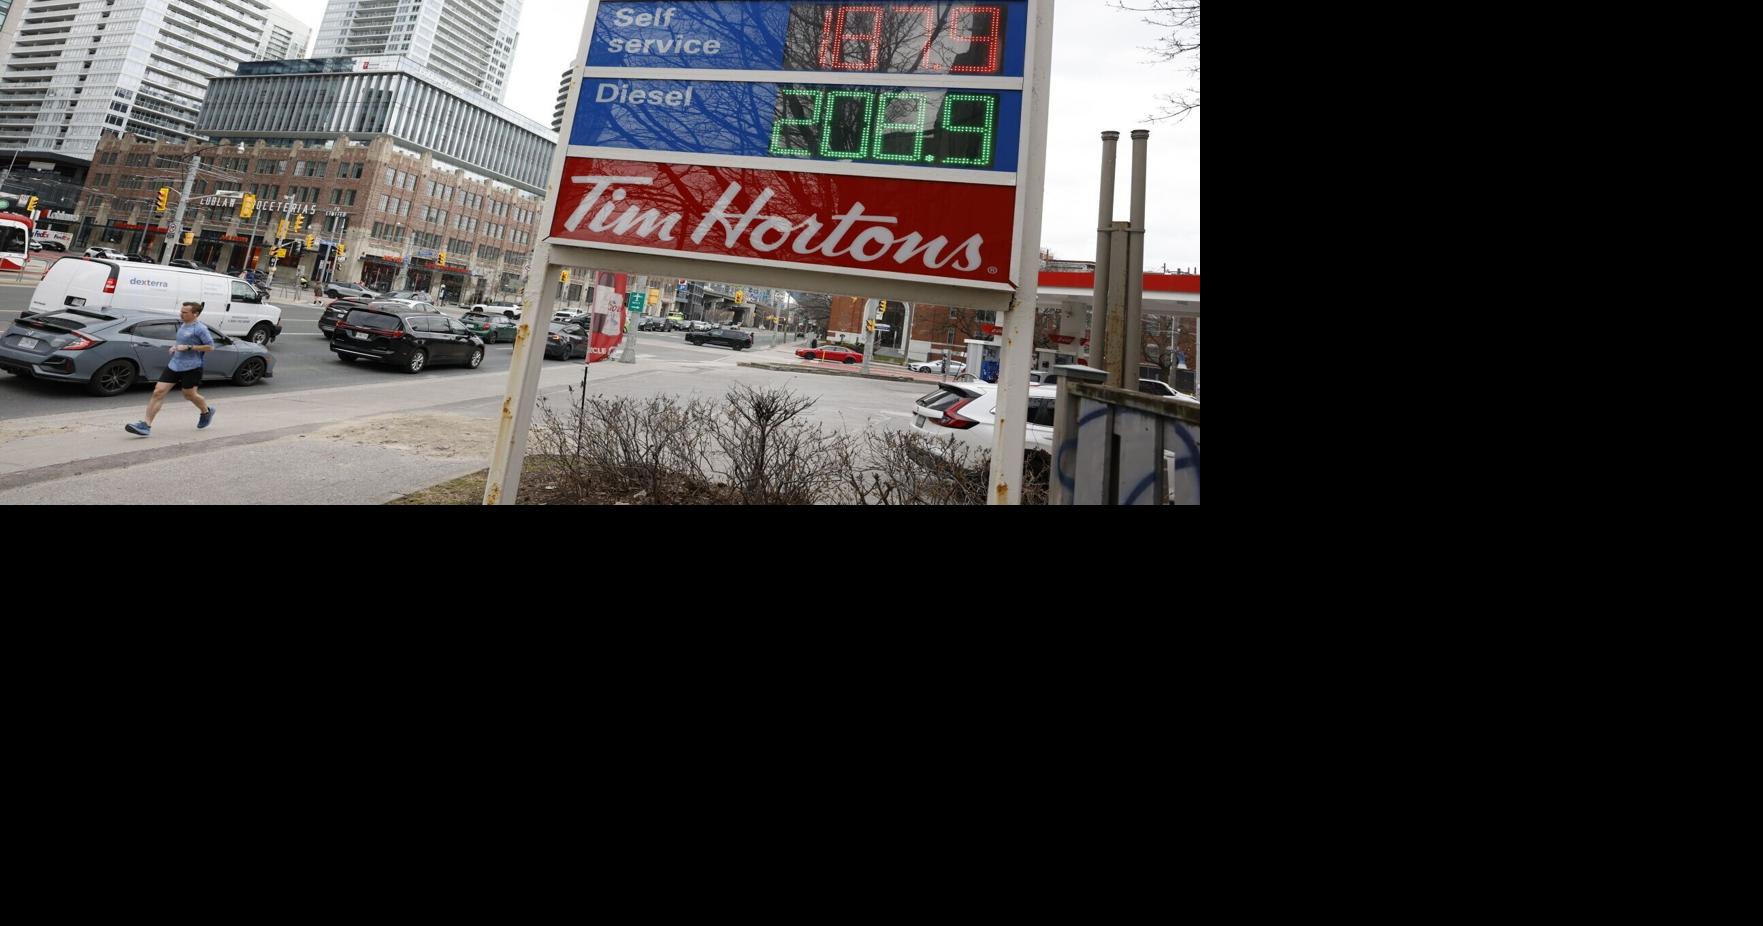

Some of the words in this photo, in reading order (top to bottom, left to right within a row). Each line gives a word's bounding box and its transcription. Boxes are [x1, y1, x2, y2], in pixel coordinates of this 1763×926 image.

[614, 7, 676, 27] Self
[608, 35, 721, 54] service
[819, 6, 1000, 72] 187.9
[595, 83, 693, 107] Diesel
[768, 89, 995, 165] 208.9
[564, 175, 682, 241] Tim
[690, 180, 984, 272] Hortons
[129, 277, 168, 288] dexterra
